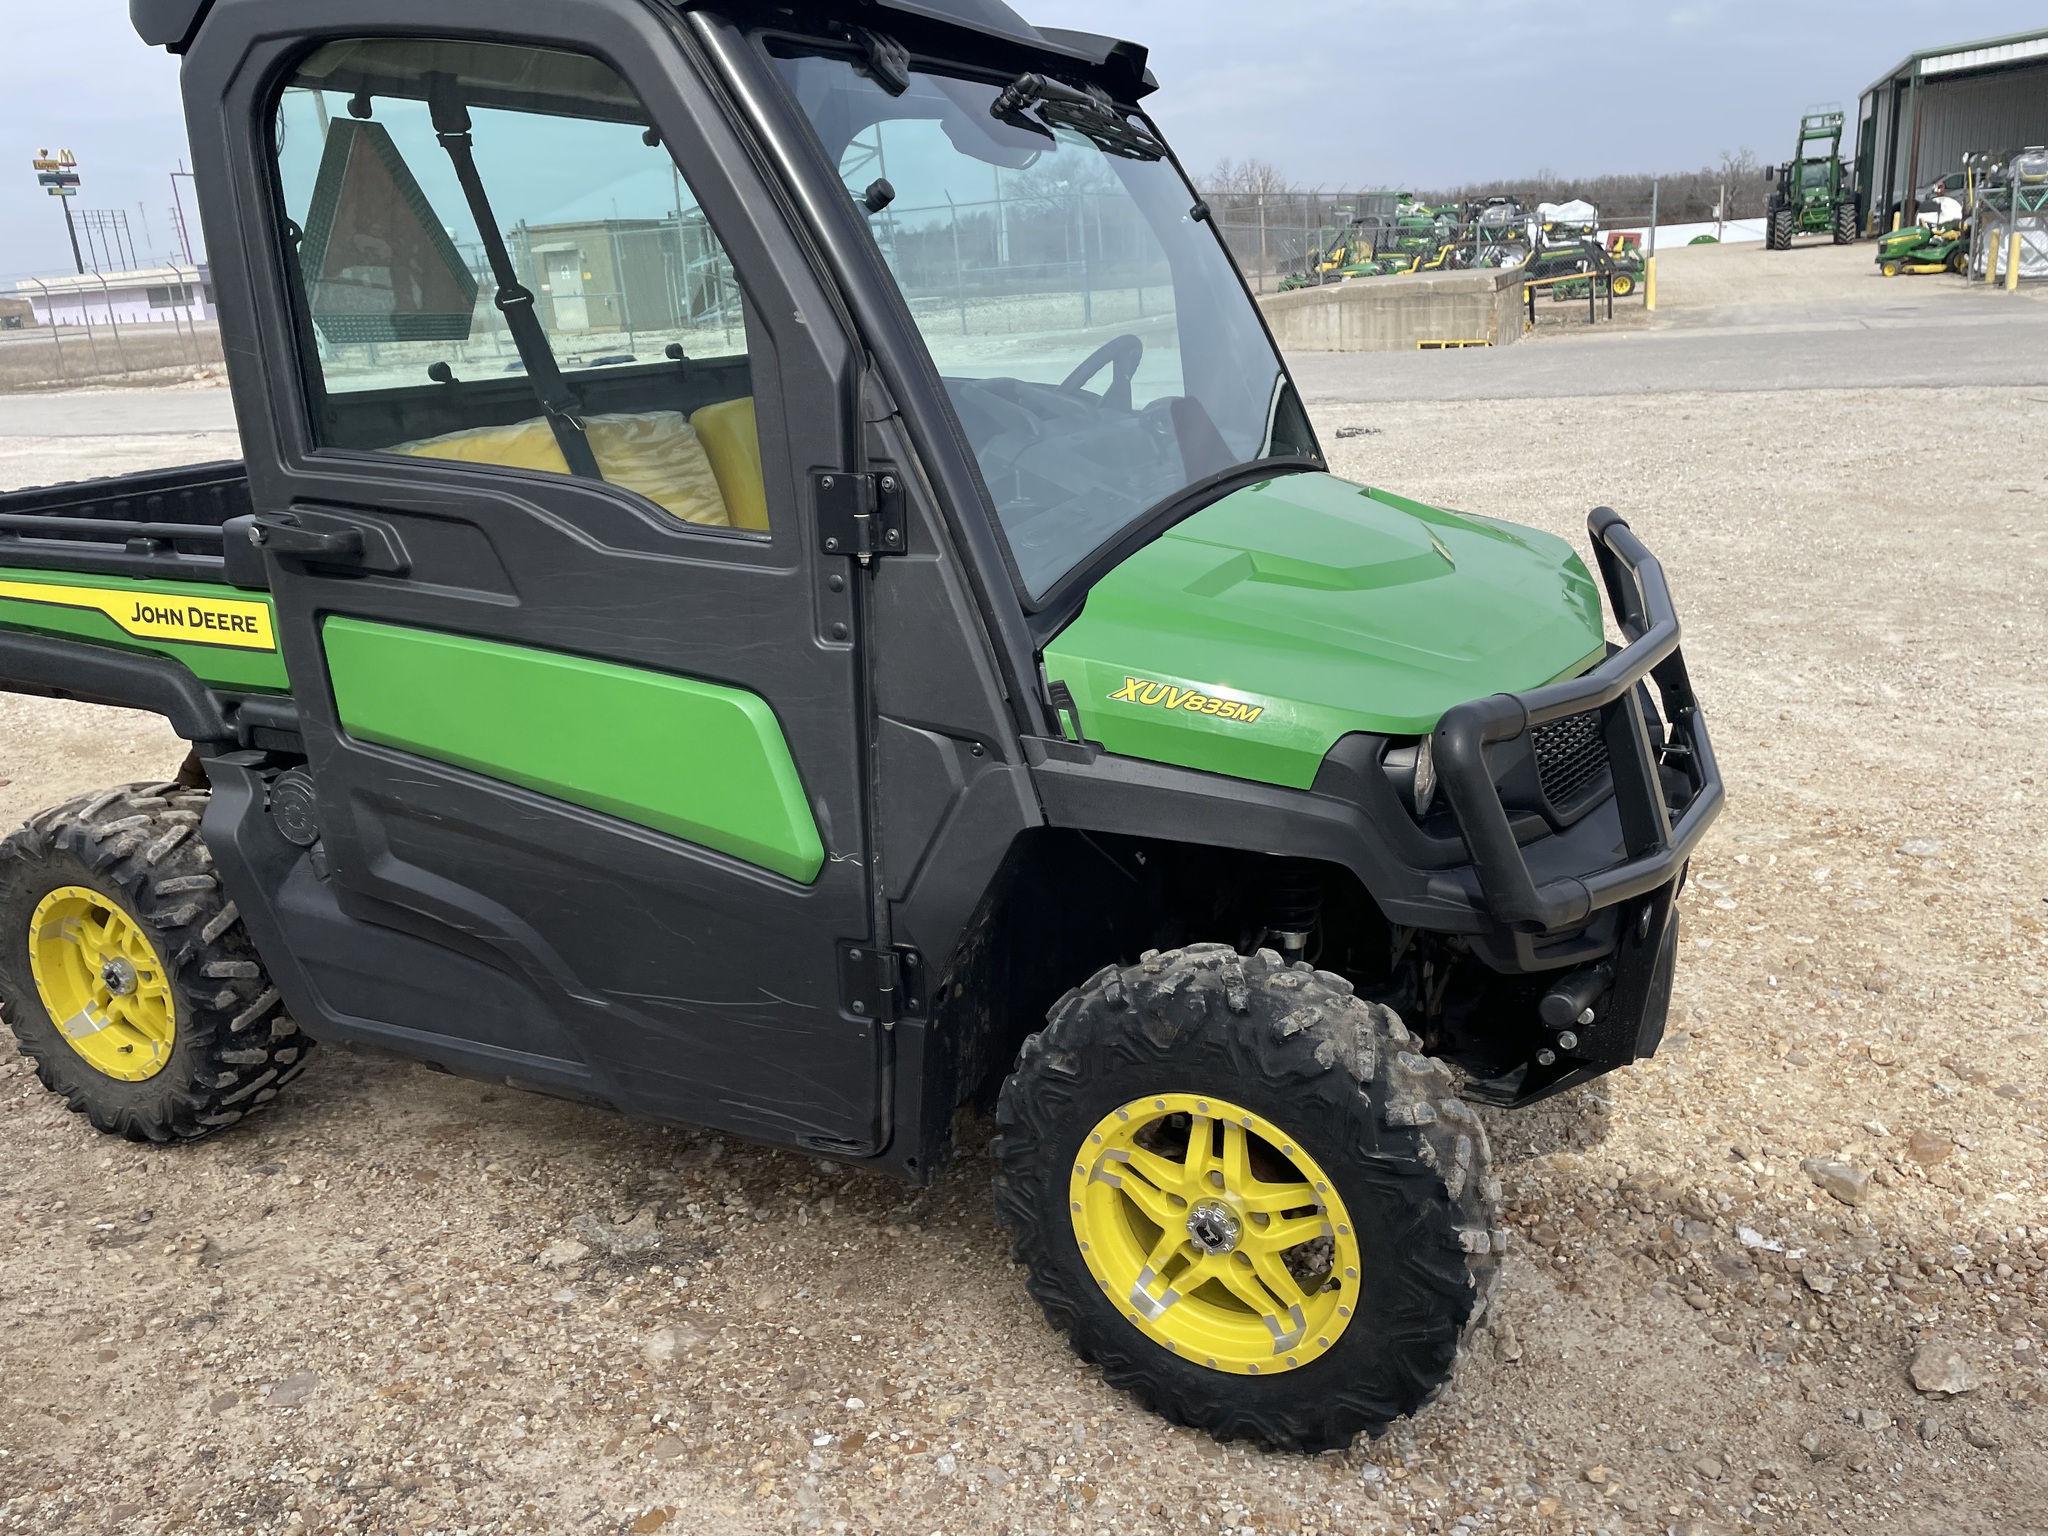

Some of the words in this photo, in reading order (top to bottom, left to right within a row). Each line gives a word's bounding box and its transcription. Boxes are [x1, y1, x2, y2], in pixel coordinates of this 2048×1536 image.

[131, 602, 184, 627] JOHN
[187, 606, 258, 634] DEERE
[1108, 676, 1264, 724] XUV835M
